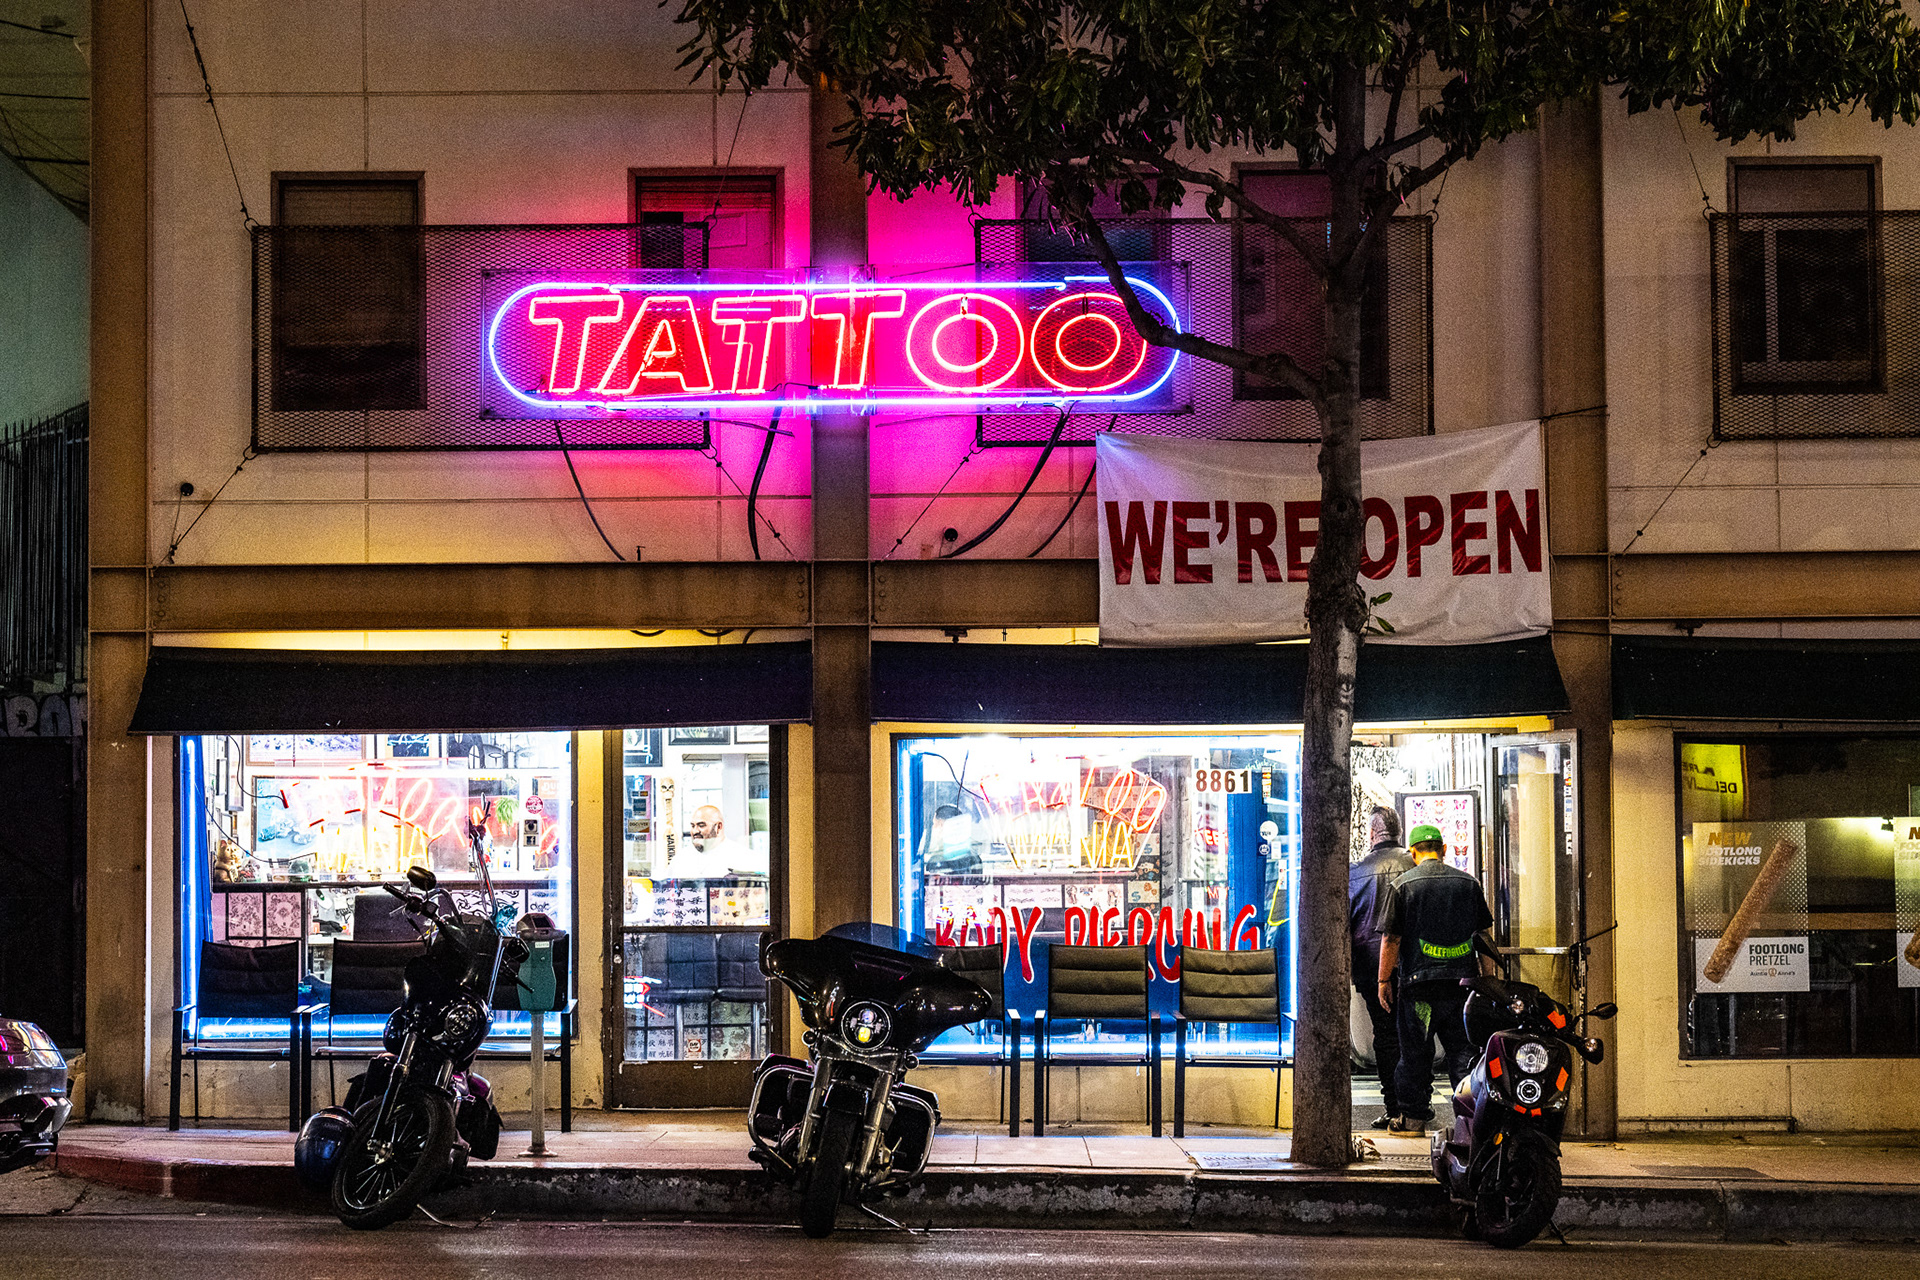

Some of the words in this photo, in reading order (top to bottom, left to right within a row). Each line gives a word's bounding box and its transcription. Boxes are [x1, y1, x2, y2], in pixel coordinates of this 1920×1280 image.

[529, 289, 1147, 394] TATTOO
[1104, 500, 1321, 585] WE'RE
[1360, 489, 1543, 581] OPEN
[1196, 769, 1249, 793] 8861
[1708, 832, 1752, 846] NEW
[1701, 846, 1762, 856] OOTLONG
[1698, 856, 1760, 866] SIDEKICKS
[1749, 944, 1805, 955] FOOTLONG
[1749, 955, 1791, 966] PRETZEL
